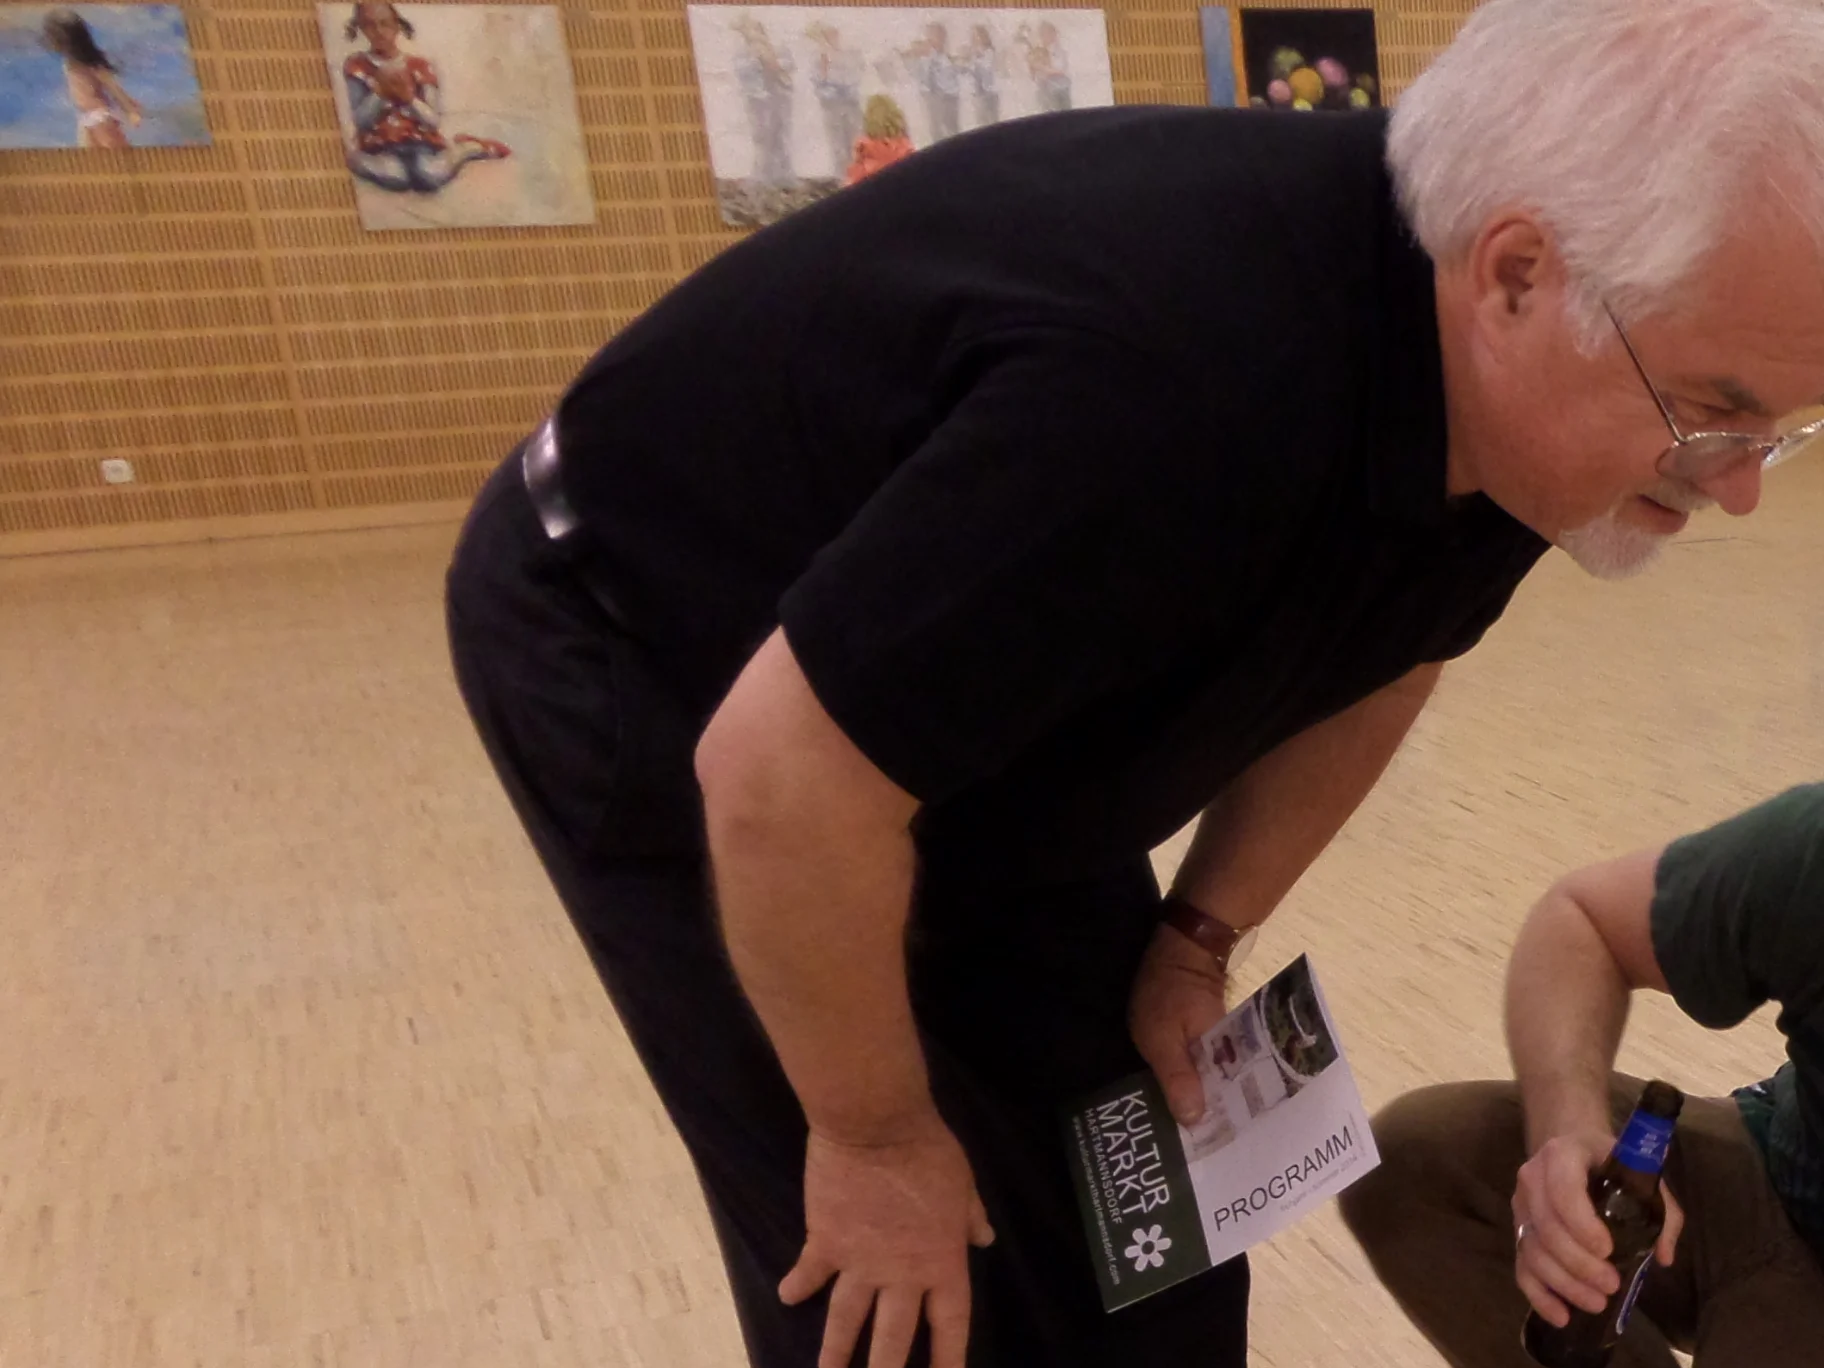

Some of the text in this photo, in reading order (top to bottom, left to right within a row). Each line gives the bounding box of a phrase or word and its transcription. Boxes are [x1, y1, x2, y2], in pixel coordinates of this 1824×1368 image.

[1085, 1108, 1122, 1224] HARTMANNSDORF
[1097, 1100, 1147, 1214] MARKT
[1120, 1090, 1170, 1211] KULTUR
[1213, 1125, 1353, 1231] PROGRAMM
